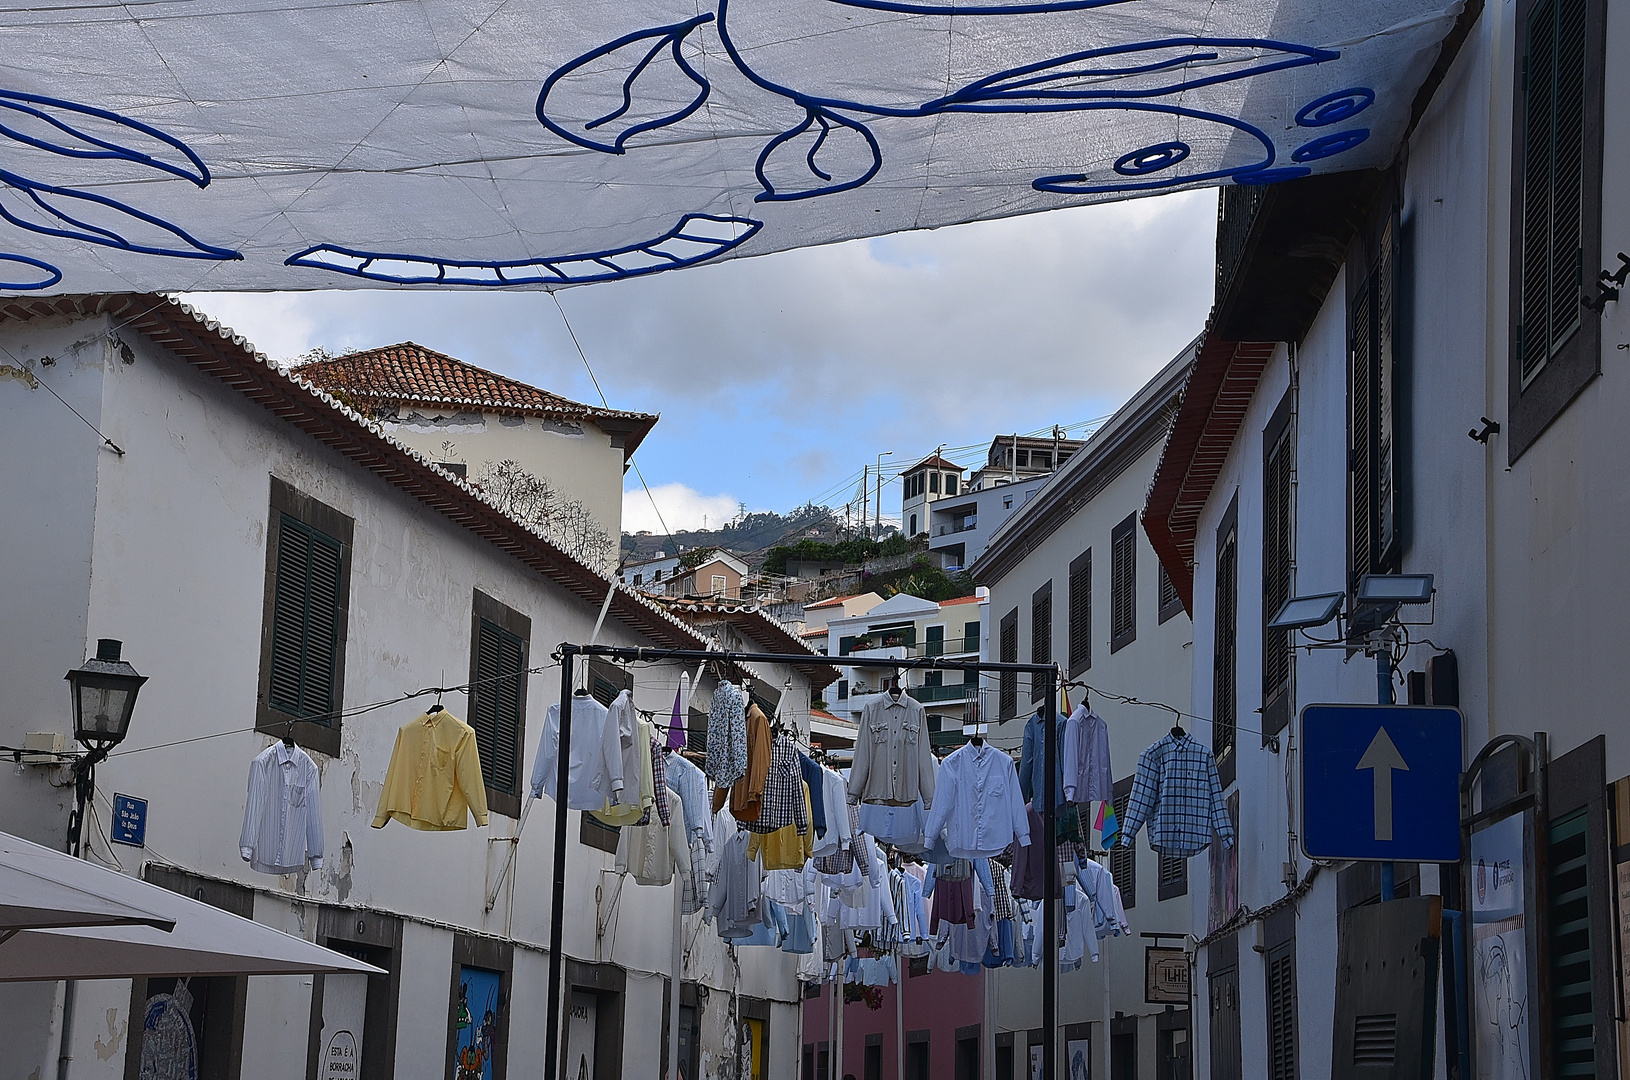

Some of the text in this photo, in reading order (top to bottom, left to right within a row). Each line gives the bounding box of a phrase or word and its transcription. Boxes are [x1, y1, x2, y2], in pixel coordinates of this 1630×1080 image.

[126, 801, 135, 810] Rua
[121, 810, 140, 821] São João
[127, 821, 138, 830] Deus
[331, 1044, 354, 1058] ESTA É A
[329, 1061, 354, 1073] BORRACHA
